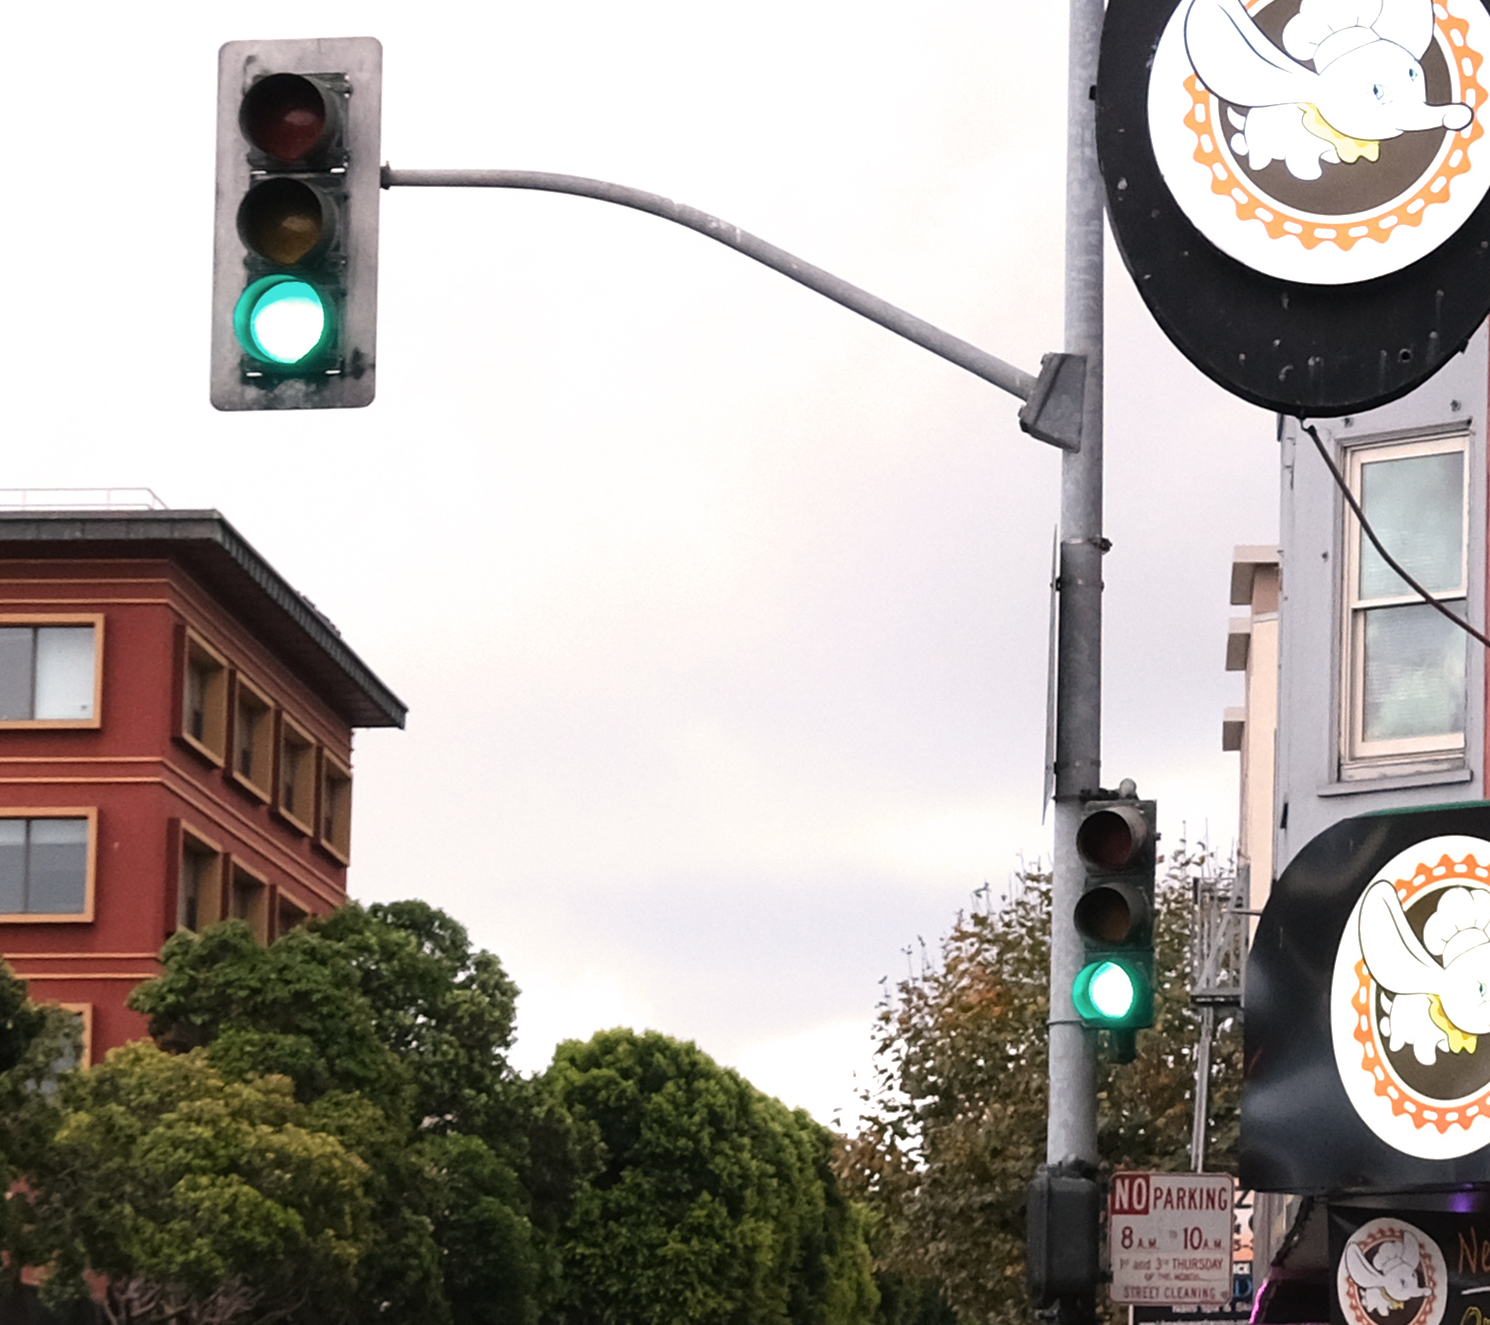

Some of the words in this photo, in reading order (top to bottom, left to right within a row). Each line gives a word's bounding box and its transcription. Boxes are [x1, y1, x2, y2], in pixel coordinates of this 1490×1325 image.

[1114, 1178, 1148, 1212] NO
[1153, 1186, 1228, 1212] PARKING
[1121, 1226, 1134, 1250] 8
[1183, 1226, 1203, 1250] 10
[1172, 1258, 1224, 1270] THURSDAY
[1123, 1286, 1159, 1300] STREET
[1164, 1286, 1216, 1300] CLEANING
